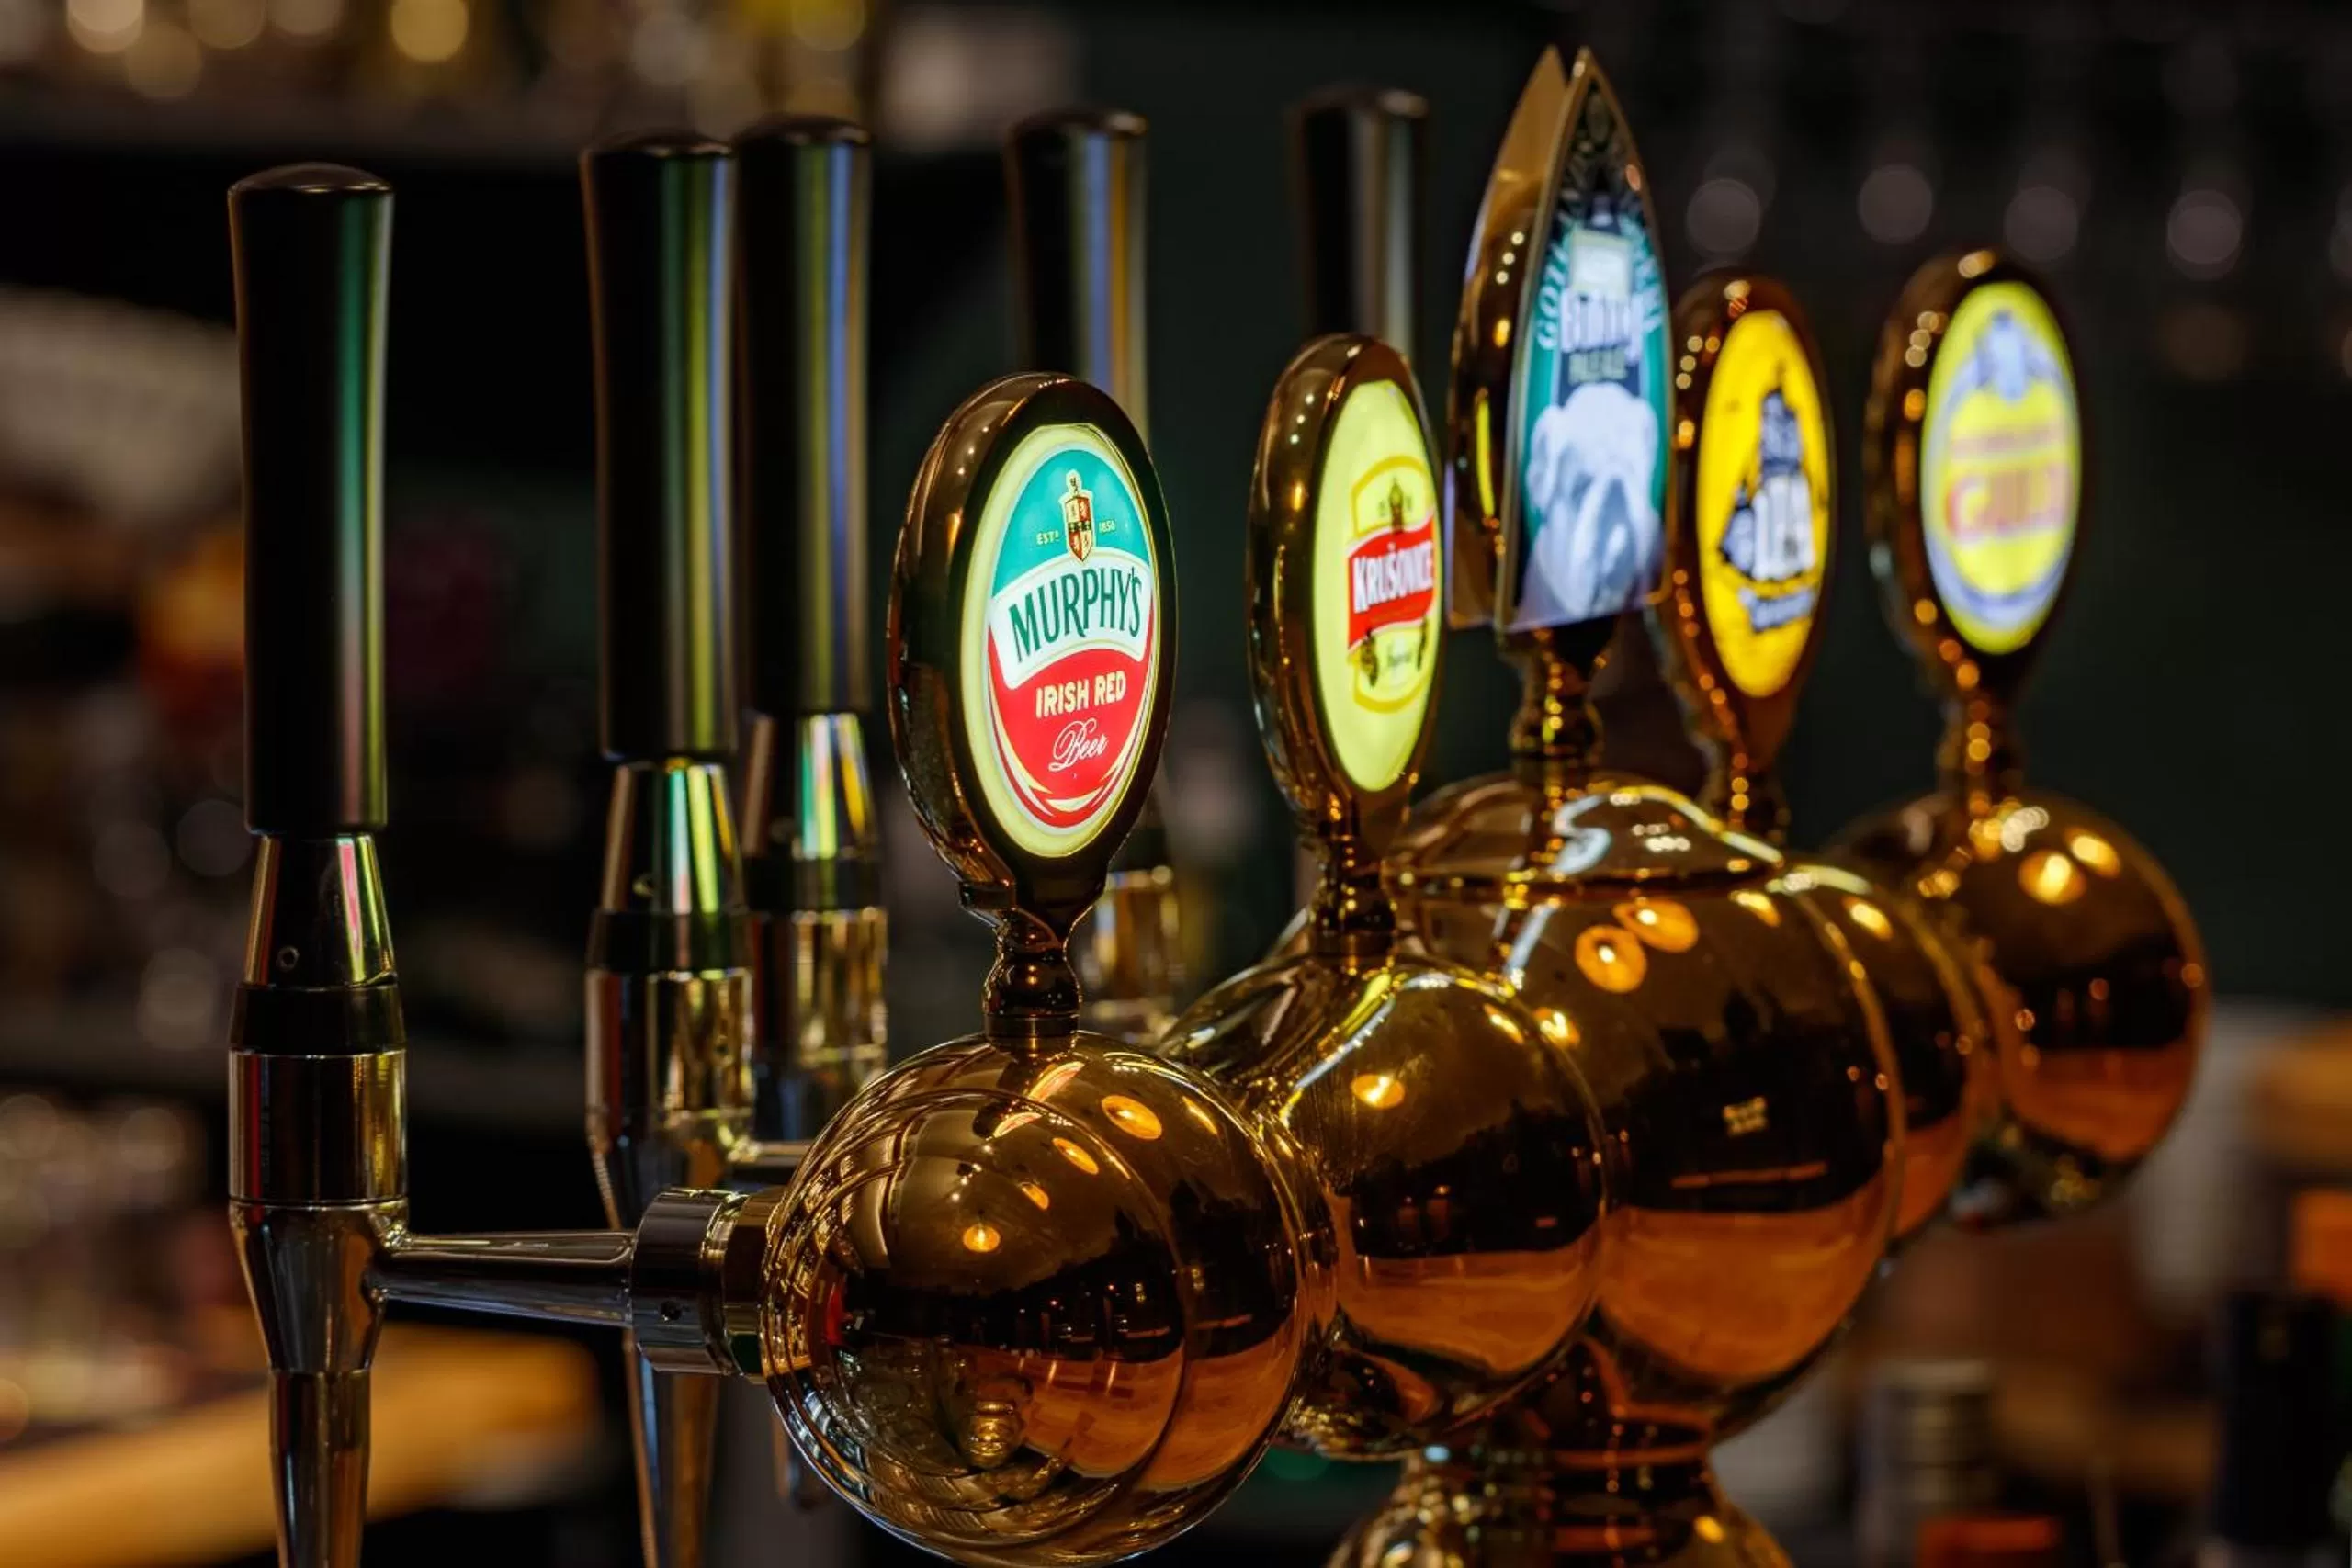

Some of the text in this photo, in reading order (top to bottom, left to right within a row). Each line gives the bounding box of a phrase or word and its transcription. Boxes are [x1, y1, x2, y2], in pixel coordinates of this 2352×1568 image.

[1008, 566, 1142, 663] MURPHY'S
[1035, 671, 1126, 718] IRISH RED
[1048, 717, 1108, 772] Beer
